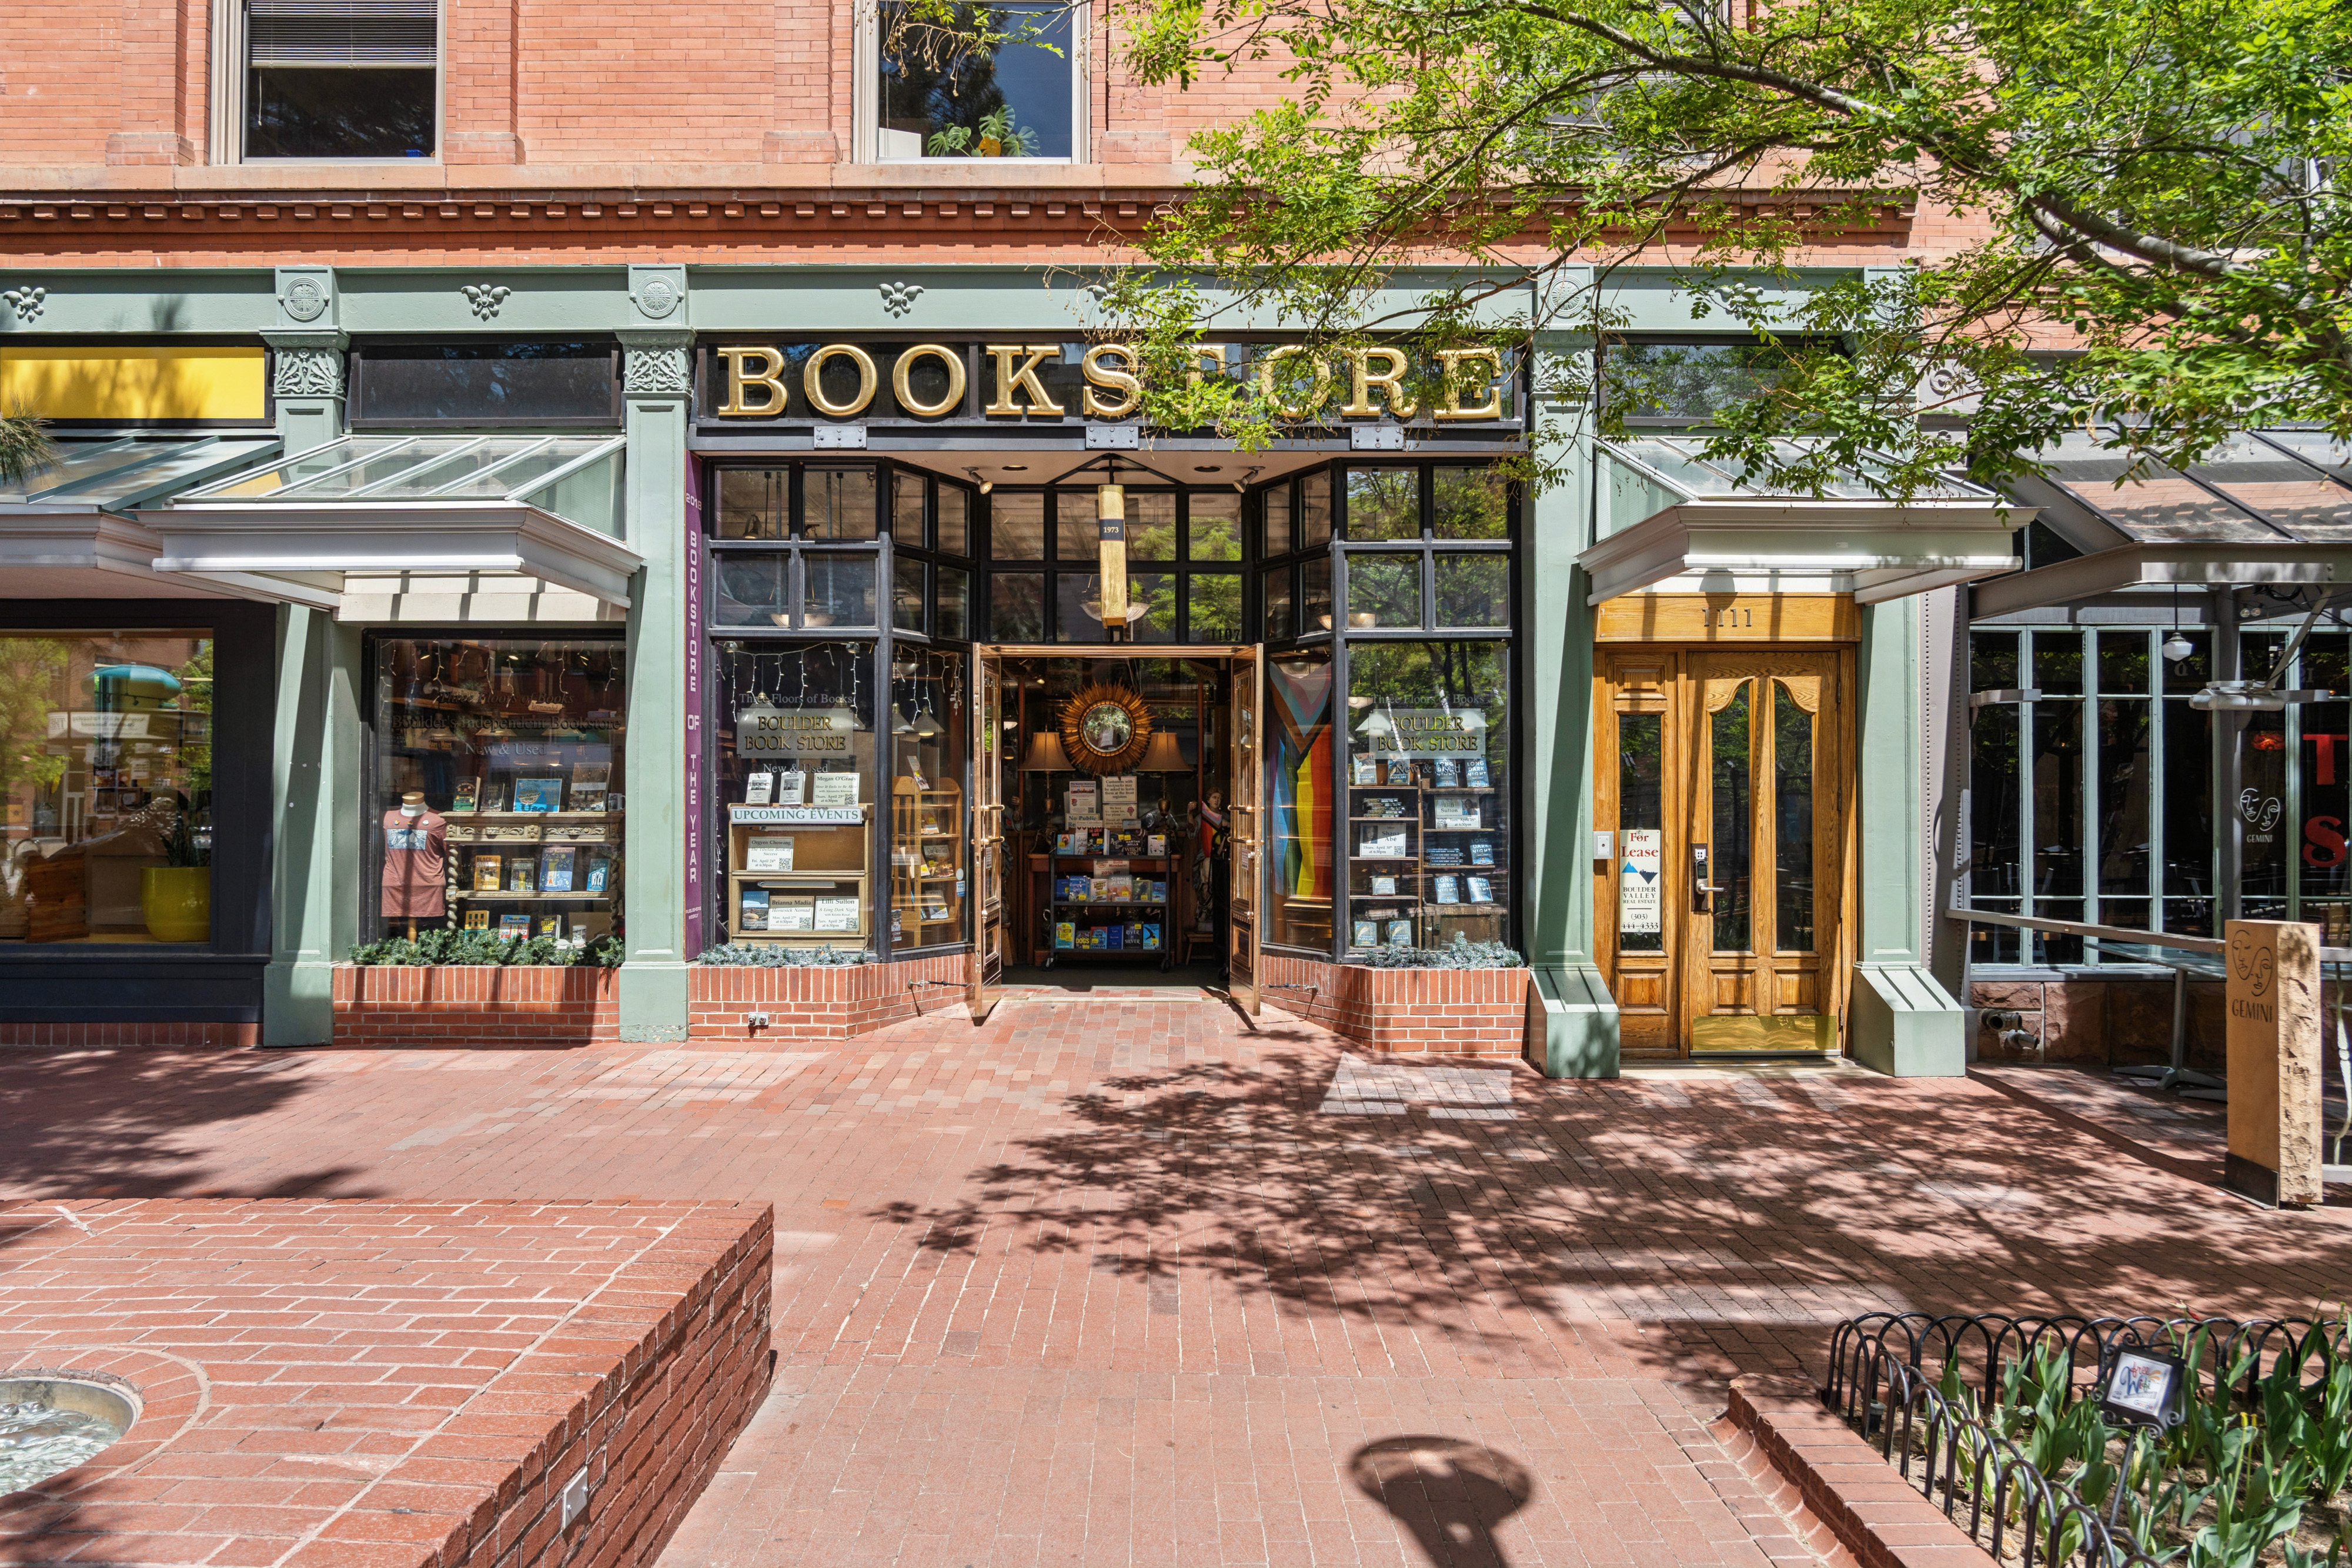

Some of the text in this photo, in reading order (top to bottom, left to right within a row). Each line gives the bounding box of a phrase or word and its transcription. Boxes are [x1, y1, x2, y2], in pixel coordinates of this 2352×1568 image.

[686, 492, 702, 510] 2018
[1702, 607, 1752, 627] 1111
[1211, 628, 1241, 641] 1107
[439, 691, 574, 704] Three Floors of Books
[739, 694, 853, 703] Three Floors of Books
[1371, 694, 1485, 704] Three Floors Books
[532, 703, 558, 711] Recommended
[392, 715, 621, 733] Boulder's Independent Bookstore
[687, 714, 699, 730] OF
[758, 716, 833, 731] BOULDER
[1391, 716, 1465, 731] BOULDER
[466, 743, 547, 755] New & Used
[746, 735, 846, 750] BOOK STORE
[1378, 735, 1478, 751] BOOK STORE
[763, 764, 828, 773] New & Used
[1395, 764, 1419, 774] New
[1422, 764, 1432, 774] &
[1435, 764, 1461, 774] Used
[734, 810, 858, 820] UPCOMING EVENTS
[1630, 833, 1649, 841] For
[2302, 815, 2346, 868] S
[1621, 846, 1658, 857] Lease
[686, 906, 701, 914] PUBLISHERS
[2232, 999, 2272, 1022] GEMINI
[2130, 1361, 2150, 1378] free
[2133, 1400, 2154, 1410] Google
